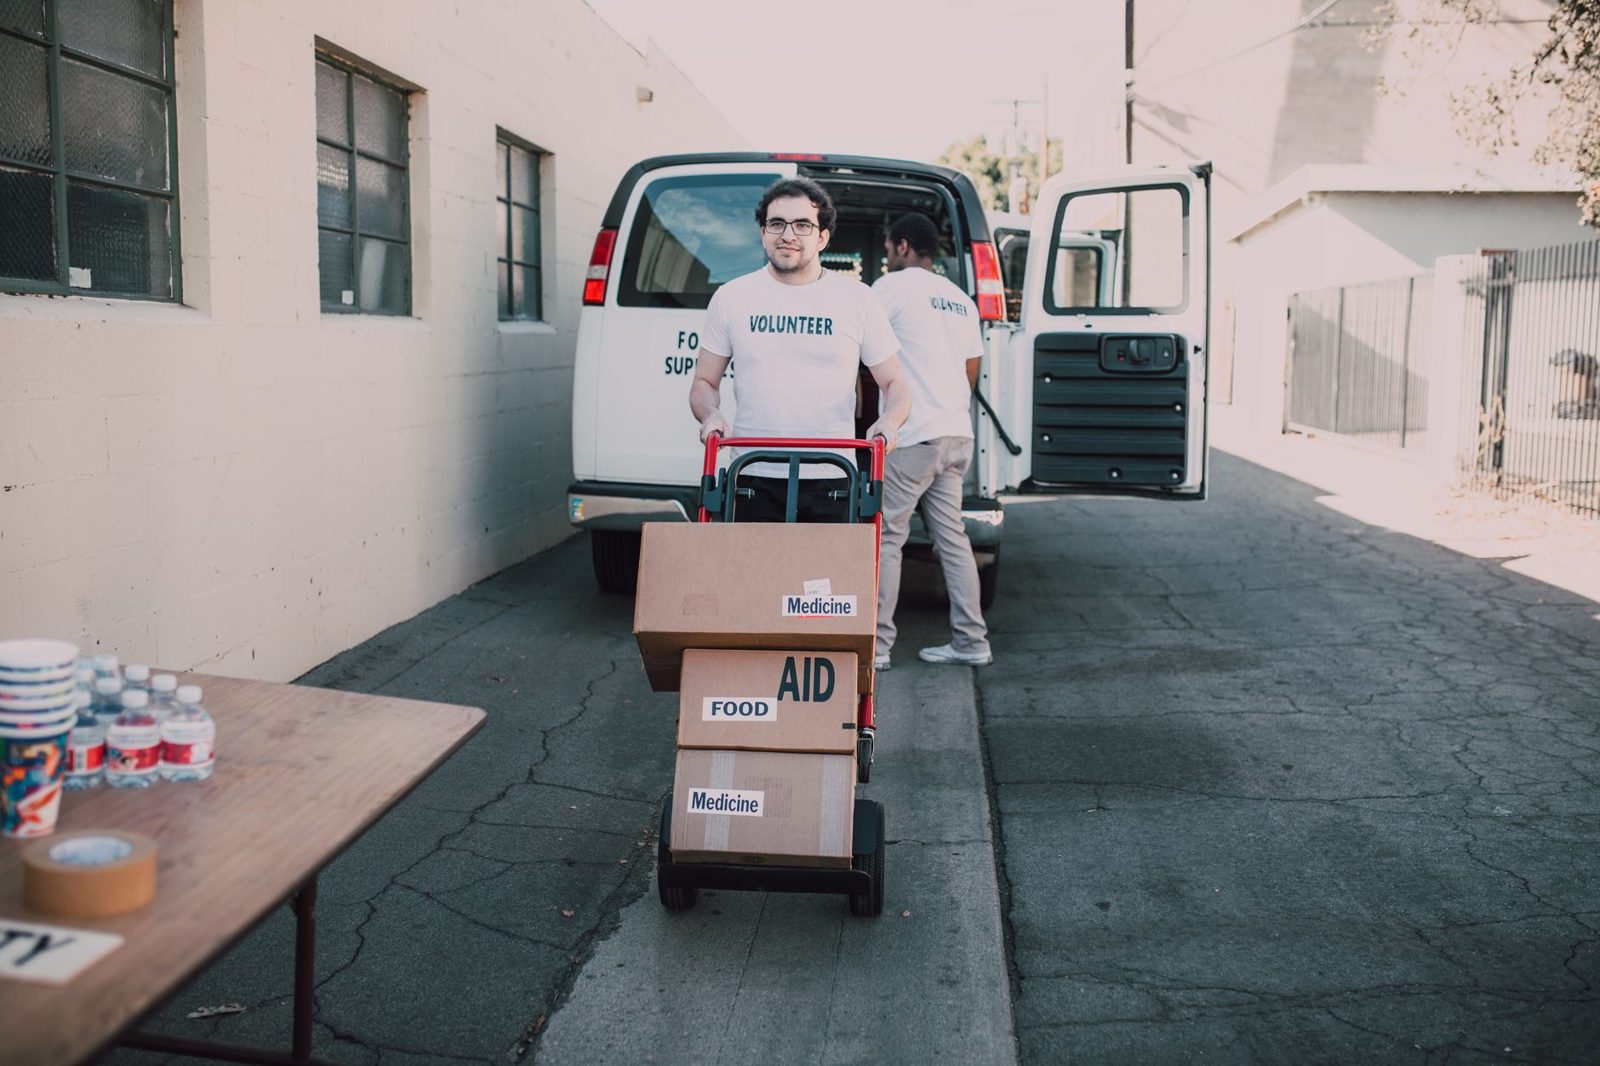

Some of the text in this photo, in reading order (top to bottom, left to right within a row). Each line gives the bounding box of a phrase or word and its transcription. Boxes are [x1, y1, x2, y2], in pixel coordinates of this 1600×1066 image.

[750, 315, 833, 335] VOLUNTEER
[678, 331, 699, 350] FO
[787, 597, 851, 614] Medicine
[777, 656, 836, 703] AID
[711, 701, 769, 716] FOOD
[691, 791, 759, 813] Medicine
